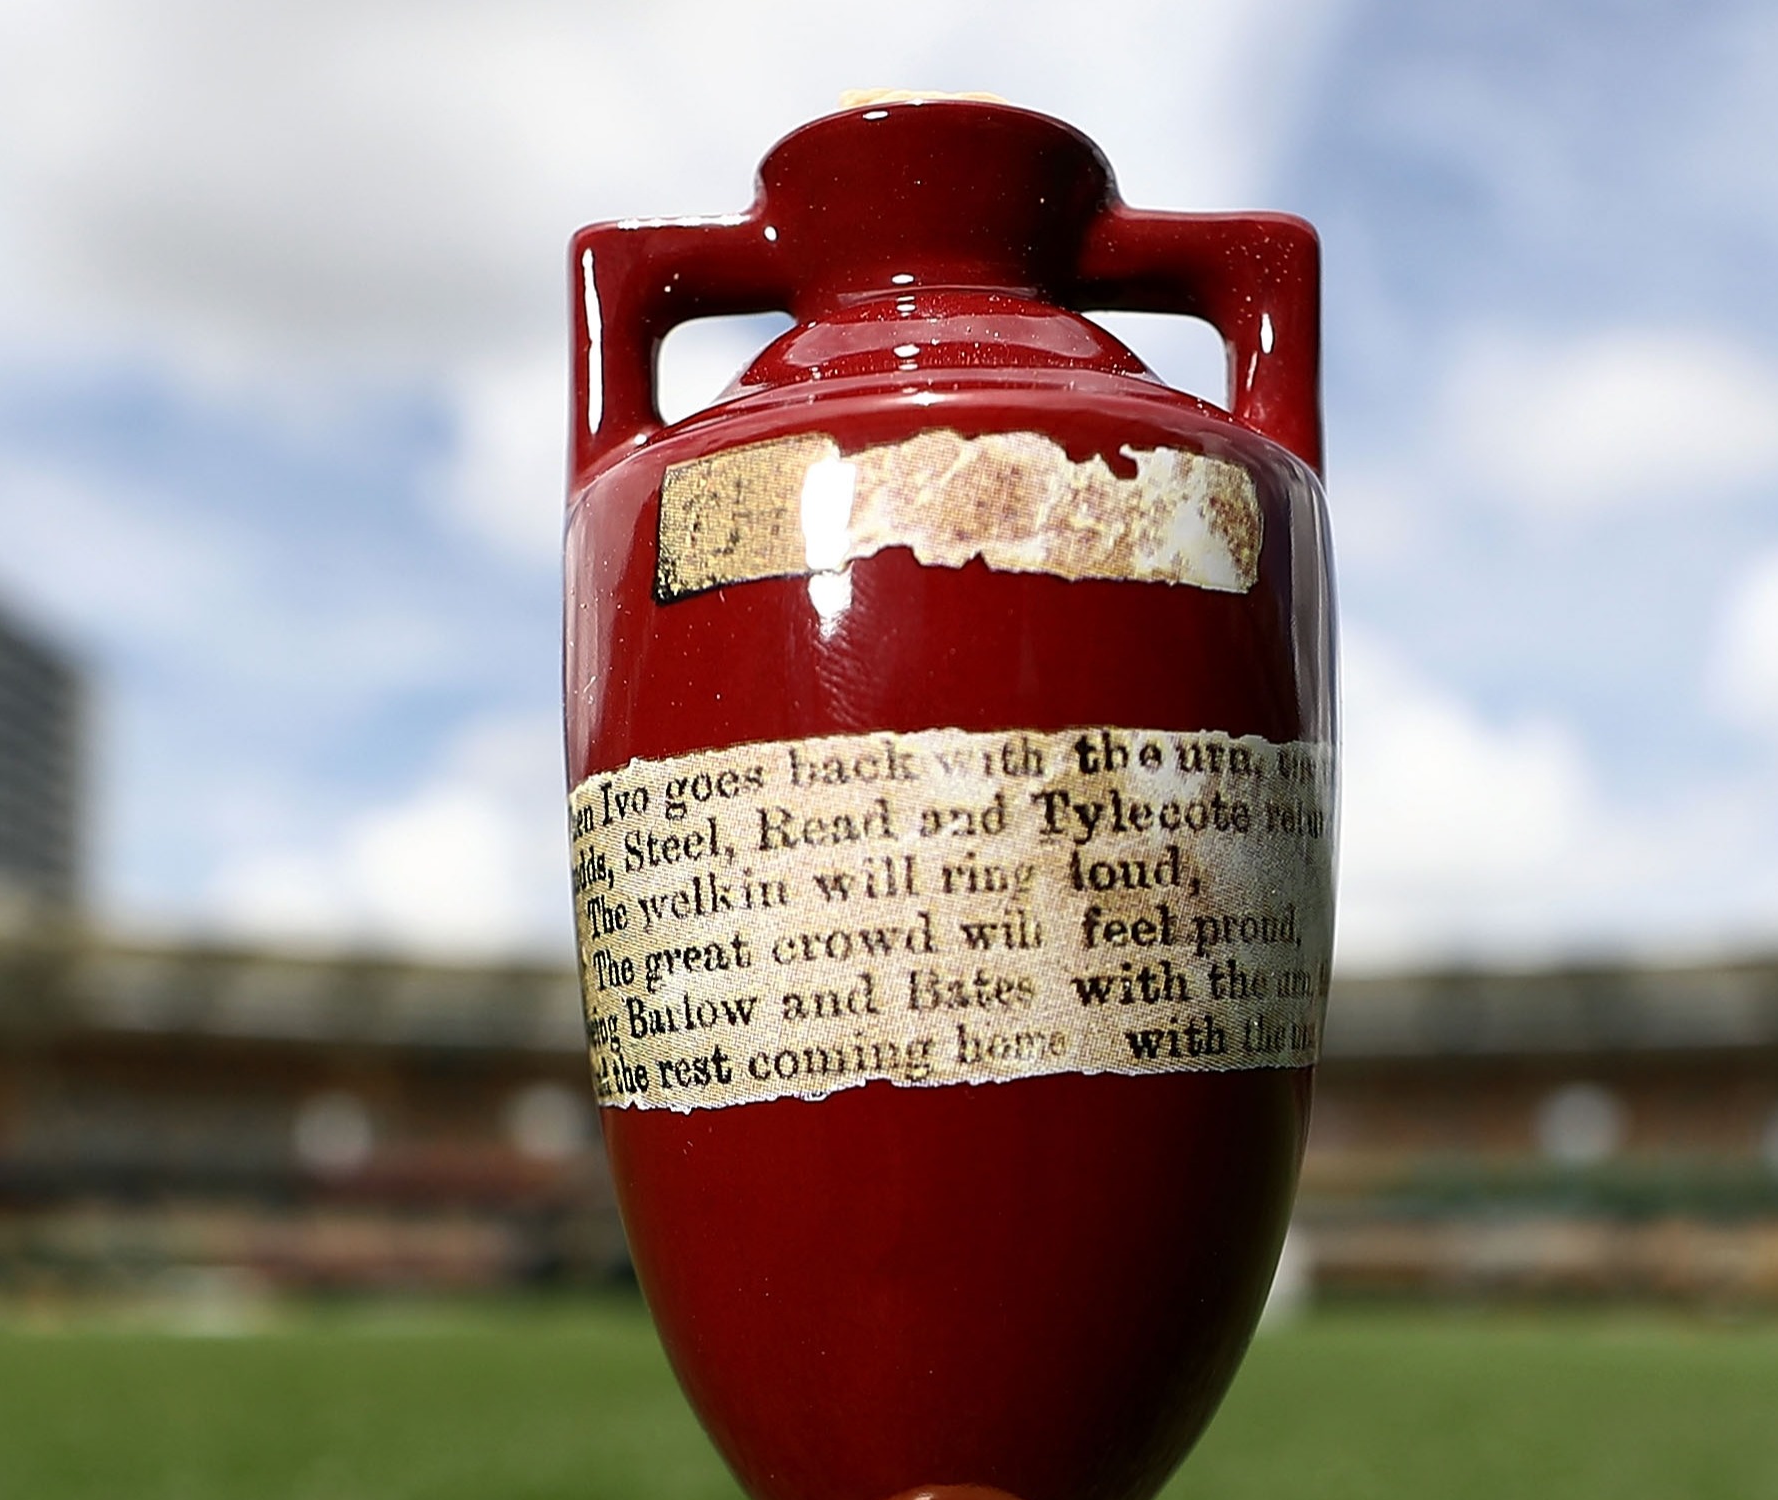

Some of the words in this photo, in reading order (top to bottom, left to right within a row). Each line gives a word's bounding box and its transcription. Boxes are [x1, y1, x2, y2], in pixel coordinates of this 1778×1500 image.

[600, 781, 649, 827] Ivo
[665, 765, 764, 821] goes
[788, 738, 921, 787] back
[1074, 731, 1162, 775] the
[624, 817, 735, 874] Steel,
[755, 797, 898, 850] Read
[920, 791, 1006, 837] and
[1029, 789, 1251, 845] Tylecote
[587, 894, 628, 941] The
[637, 866, 789, 934] welkin
[813, 854, 921, 902] will
[941, 851, 1034, 901] ring
[1070, 845, 1201, 896] loud,
[592, 948, 636, 992] The
[644, 931, 752, 994] great
[772, 910, 936, 966] crowd
[1081, 903, 1180, 950] feel
[1191, 902, 1303, 957] proud,
[782, 971, 883, 1021] and
[907, 968, 1035, 1010] Bates
[1070, 959, 1192, 1007] with
[1207, 958, 1268, 1001] the
[610, 1053, 650, 1095] the
[658, 1044, 733, 1090] rest
[747, 1029, 935, 1082] coming
[957, 1022, 1067, 1065] home
[1124, 1015, 1229, 1060] with
